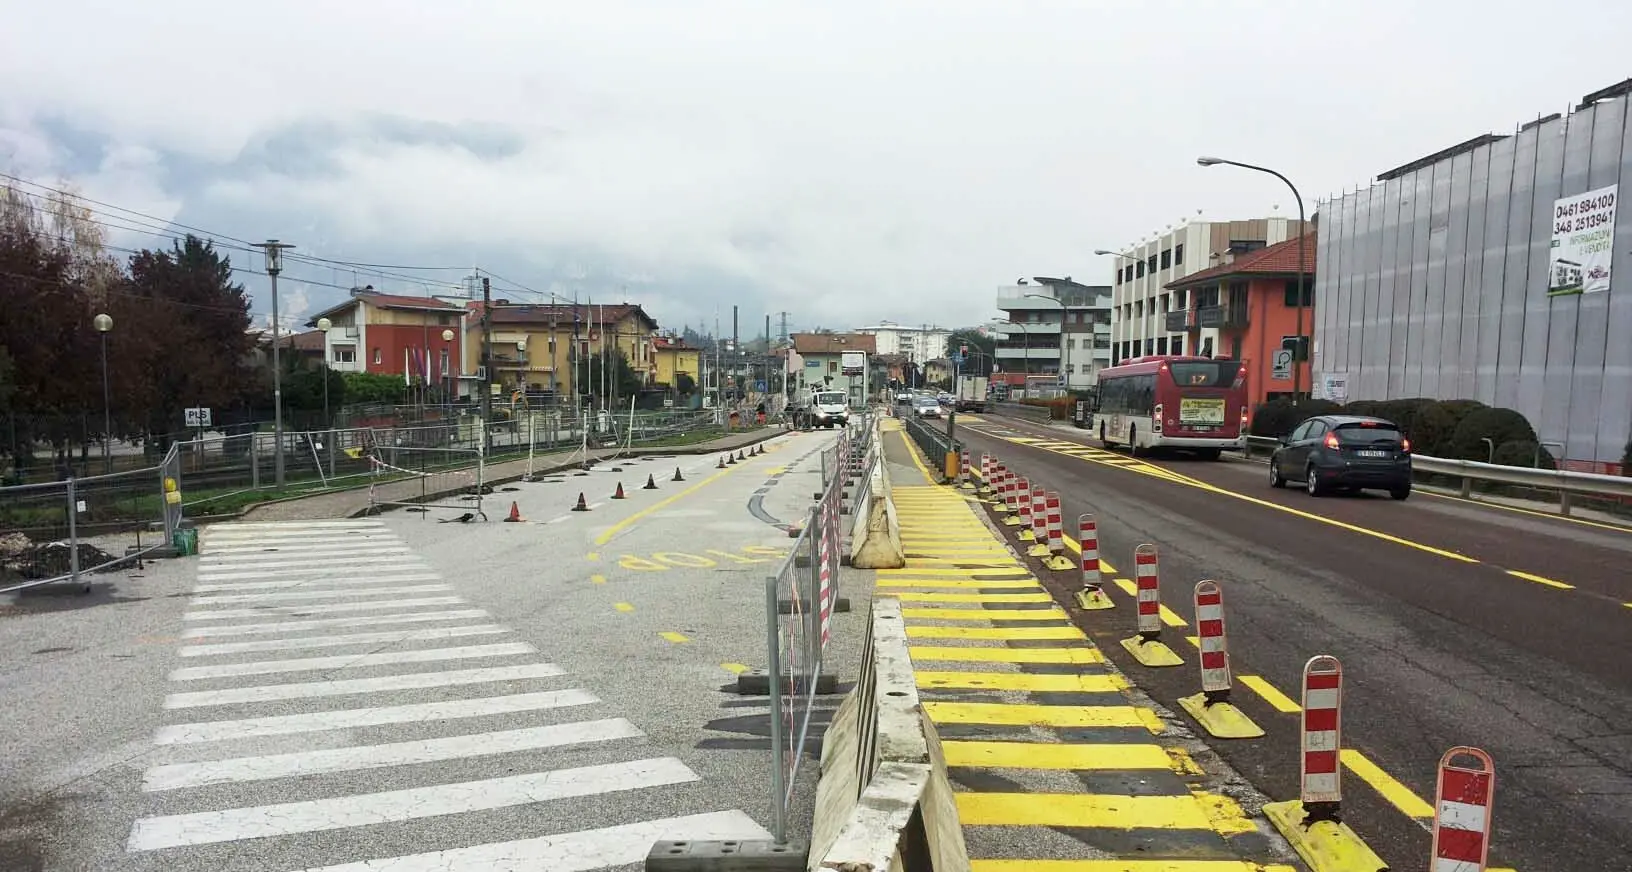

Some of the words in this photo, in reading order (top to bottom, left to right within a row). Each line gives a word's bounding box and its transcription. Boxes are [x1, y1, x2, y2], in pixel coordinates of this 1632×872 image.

[1554, 220, 1572, 234] 348
[1575, 210, 1613, 231] 2513941
[1192, 375, 1206, 384] 17
